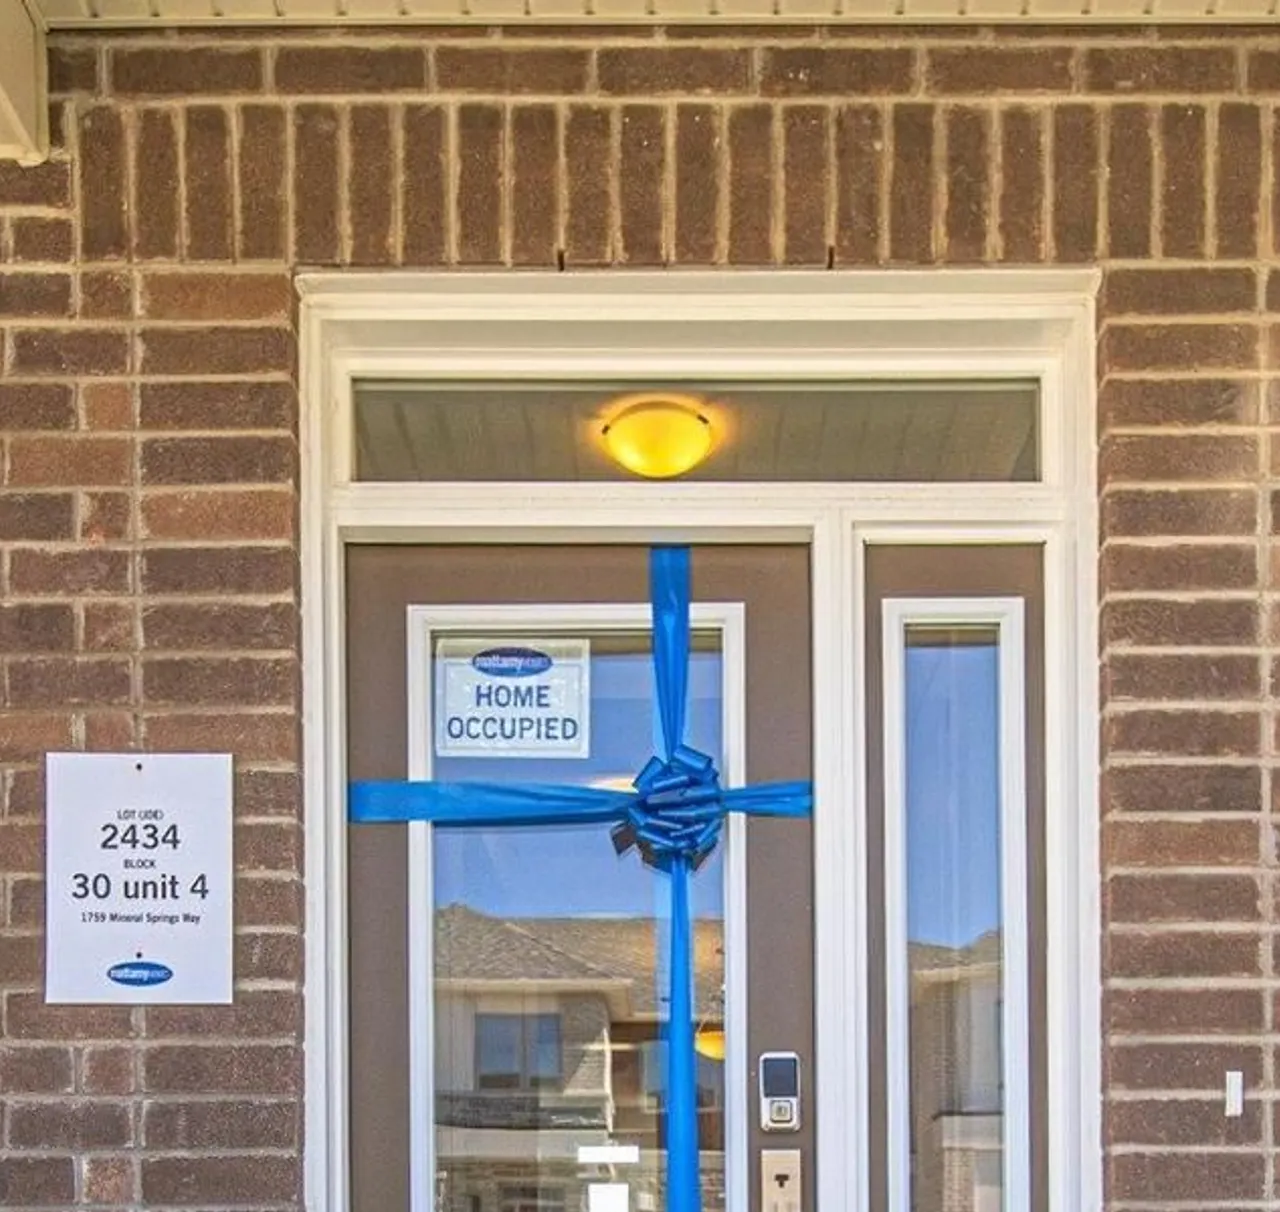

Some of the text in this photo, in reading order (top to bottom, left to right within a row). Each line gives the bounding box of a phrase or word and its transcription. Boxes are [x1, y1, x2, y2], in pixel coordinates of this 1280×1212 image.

[475, 684, 551, 708] HOME
[447, 716, 578, 740] OCCUPIED
[116, 809, 136, 820] LOT
[100, 823, 180, 850] 2434
[123, 858, 157, 869] BLOCK
[71, 873, 209, 899] 30 unit 4
[81, 912, 107, 923] 1759
[145, 911, 180, 925] Springs
[182, 912, 201, 925] Way
